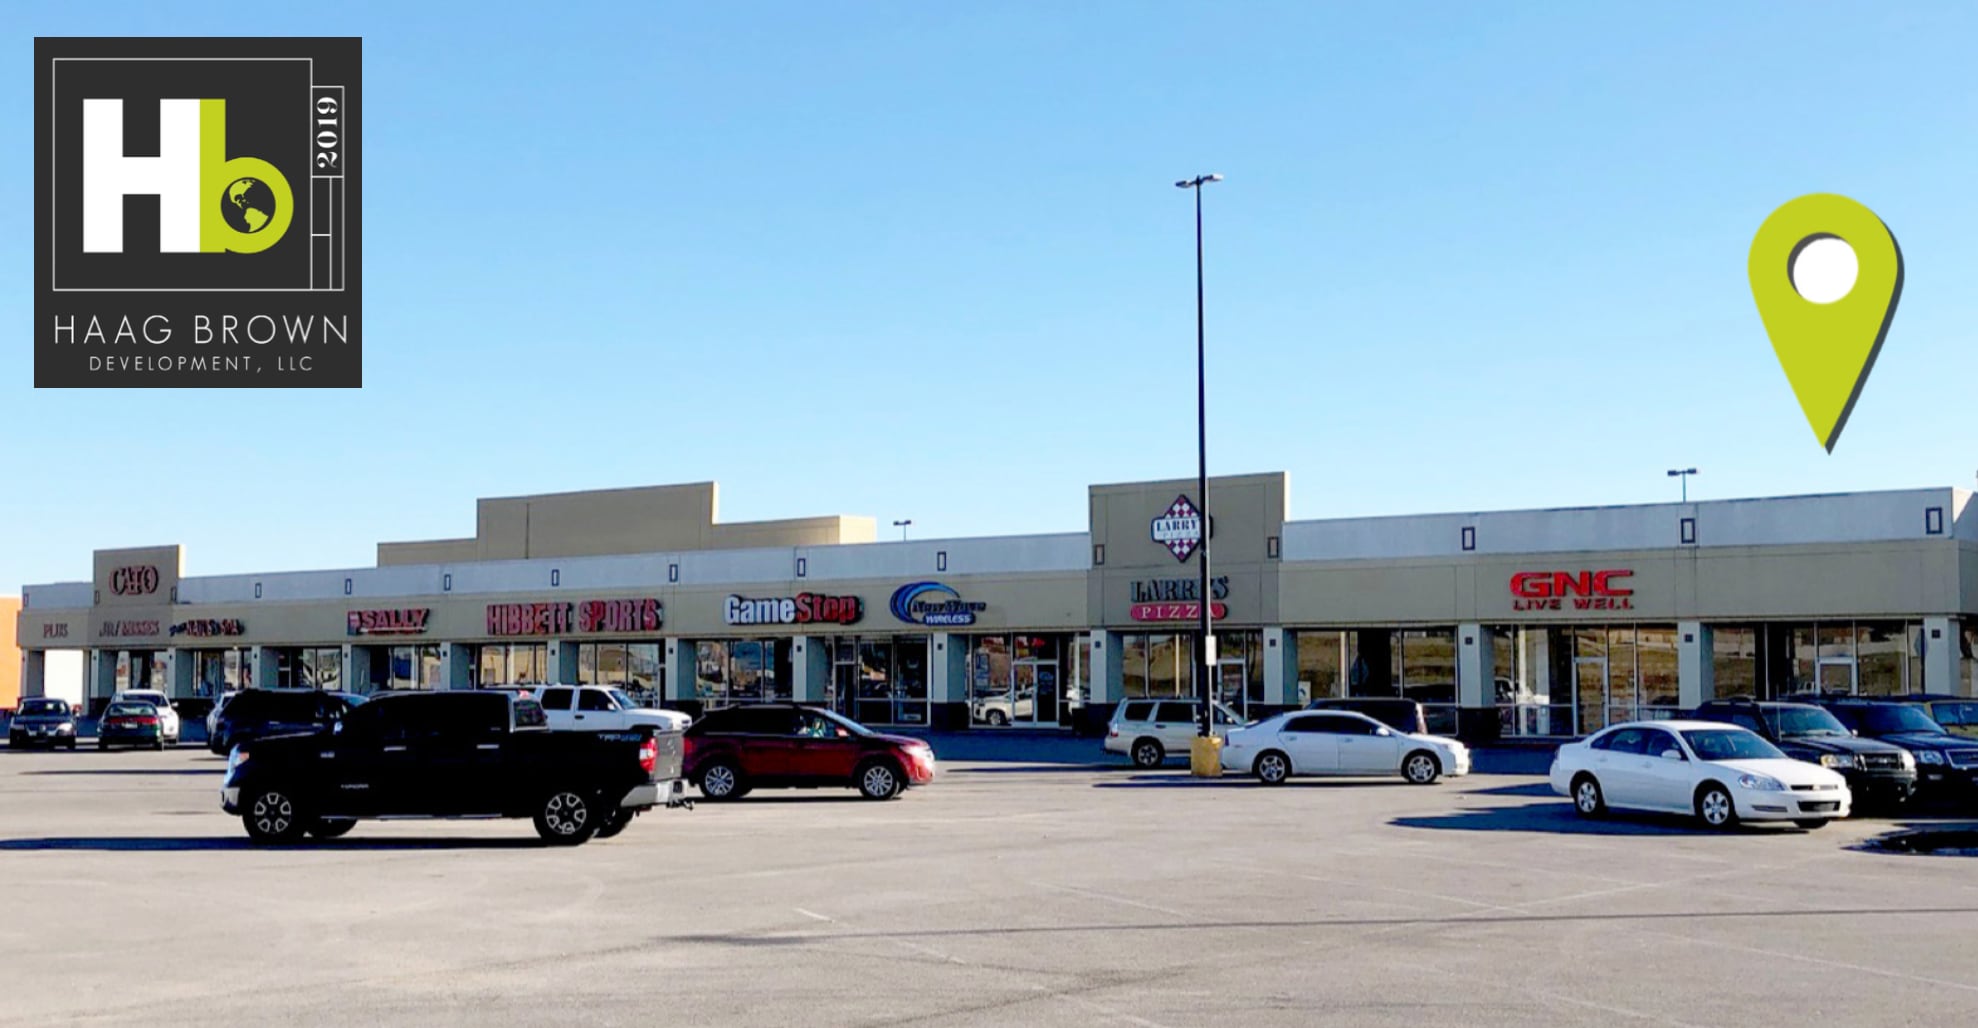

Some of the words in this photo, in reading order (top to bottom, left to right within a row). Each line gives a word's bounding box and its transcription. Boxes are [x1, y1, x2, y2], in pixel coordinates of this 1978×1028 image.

[109, 566, 159, 595] CATO
[1510, 569, 1633, 597] GNC
[361, 608, 429, 628] SALLY
[487, 603, 574, 635] HIBBETT
[579, 598, 663, 632] SPORTS
[724, 592, 862, 625] GameStop
[1513, 599, 1562, 611] LIVE
[1573, 598, 1635, 610] WELL
